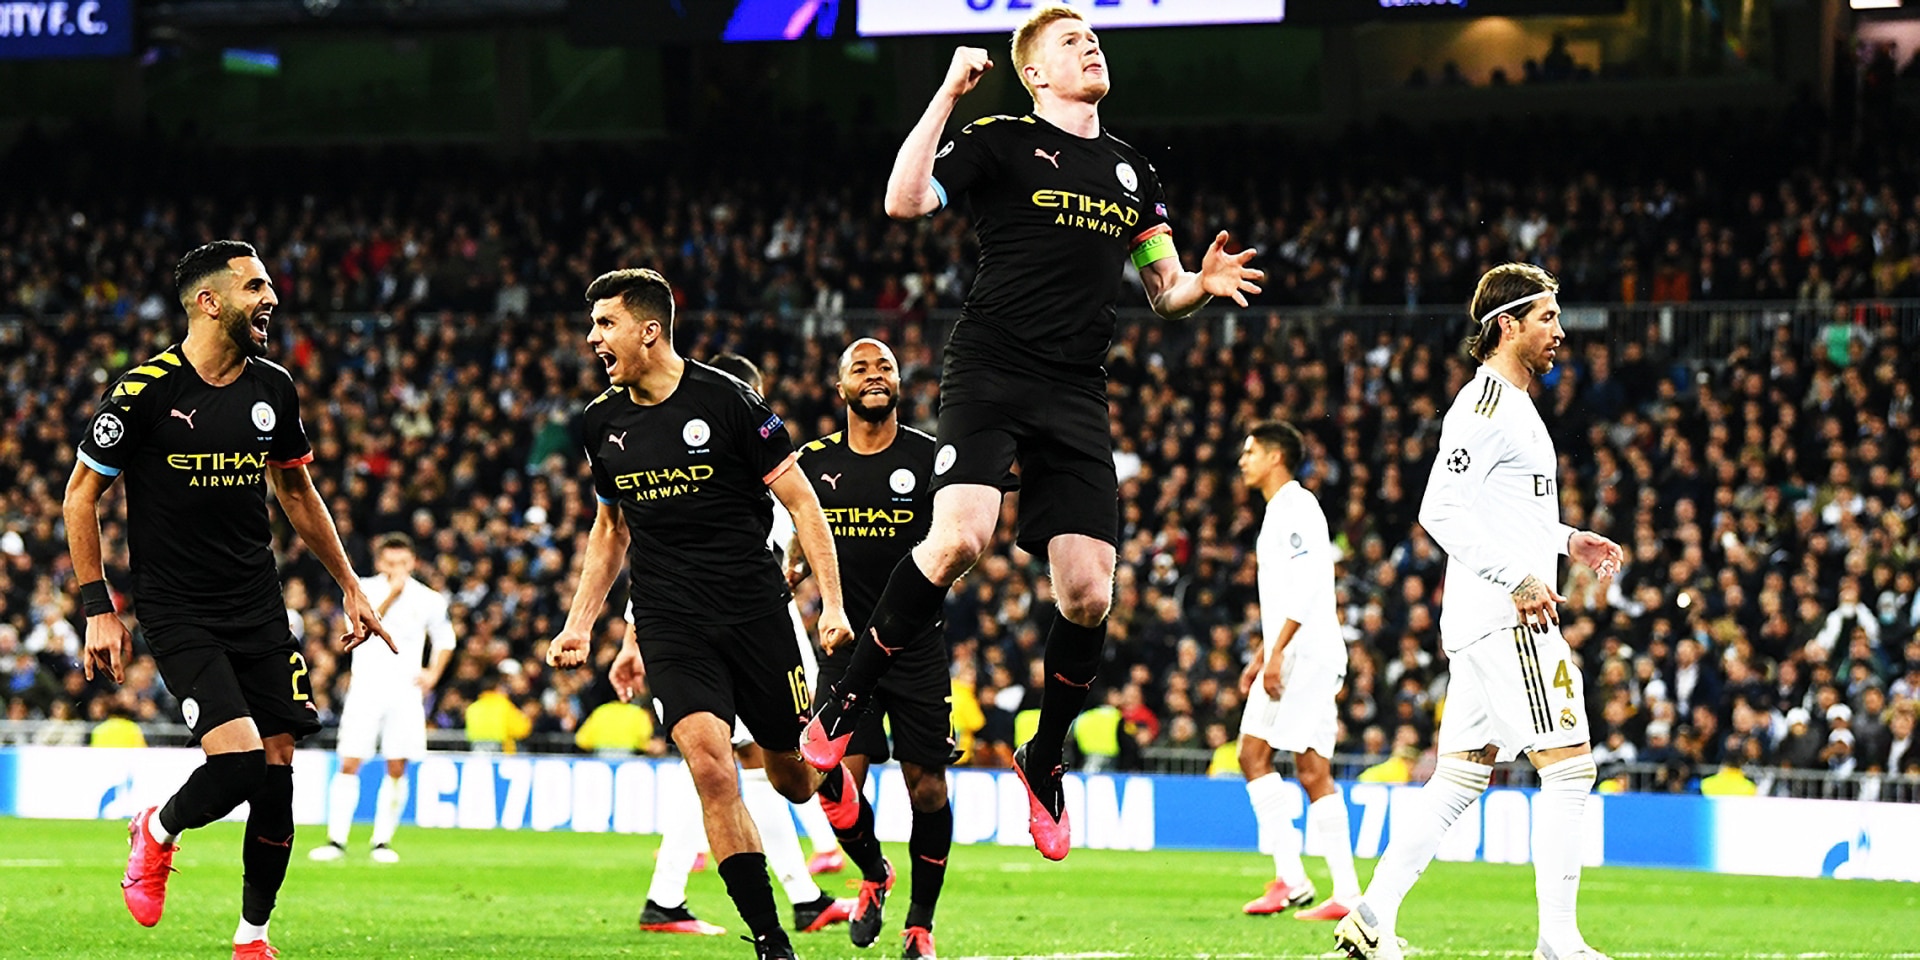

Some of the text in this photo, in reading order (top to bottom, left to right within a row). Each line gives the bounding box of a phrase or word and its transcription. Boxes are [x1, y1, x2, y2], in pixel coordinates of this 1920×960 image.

[1032, 189, 1139, 227] ETIHAD
[1055, 212, 1123, 238] AIRWAYS
[189, 473, 261, 487] AIRWAYS
[615, 464, 713, 490] ETIHAD
[834, 526, 896, 537] AIRWAYS
[289, 651, 308, 700] 2
[787, 665, 809, 714] 16
[1553, 659, 1574, 699] 4
